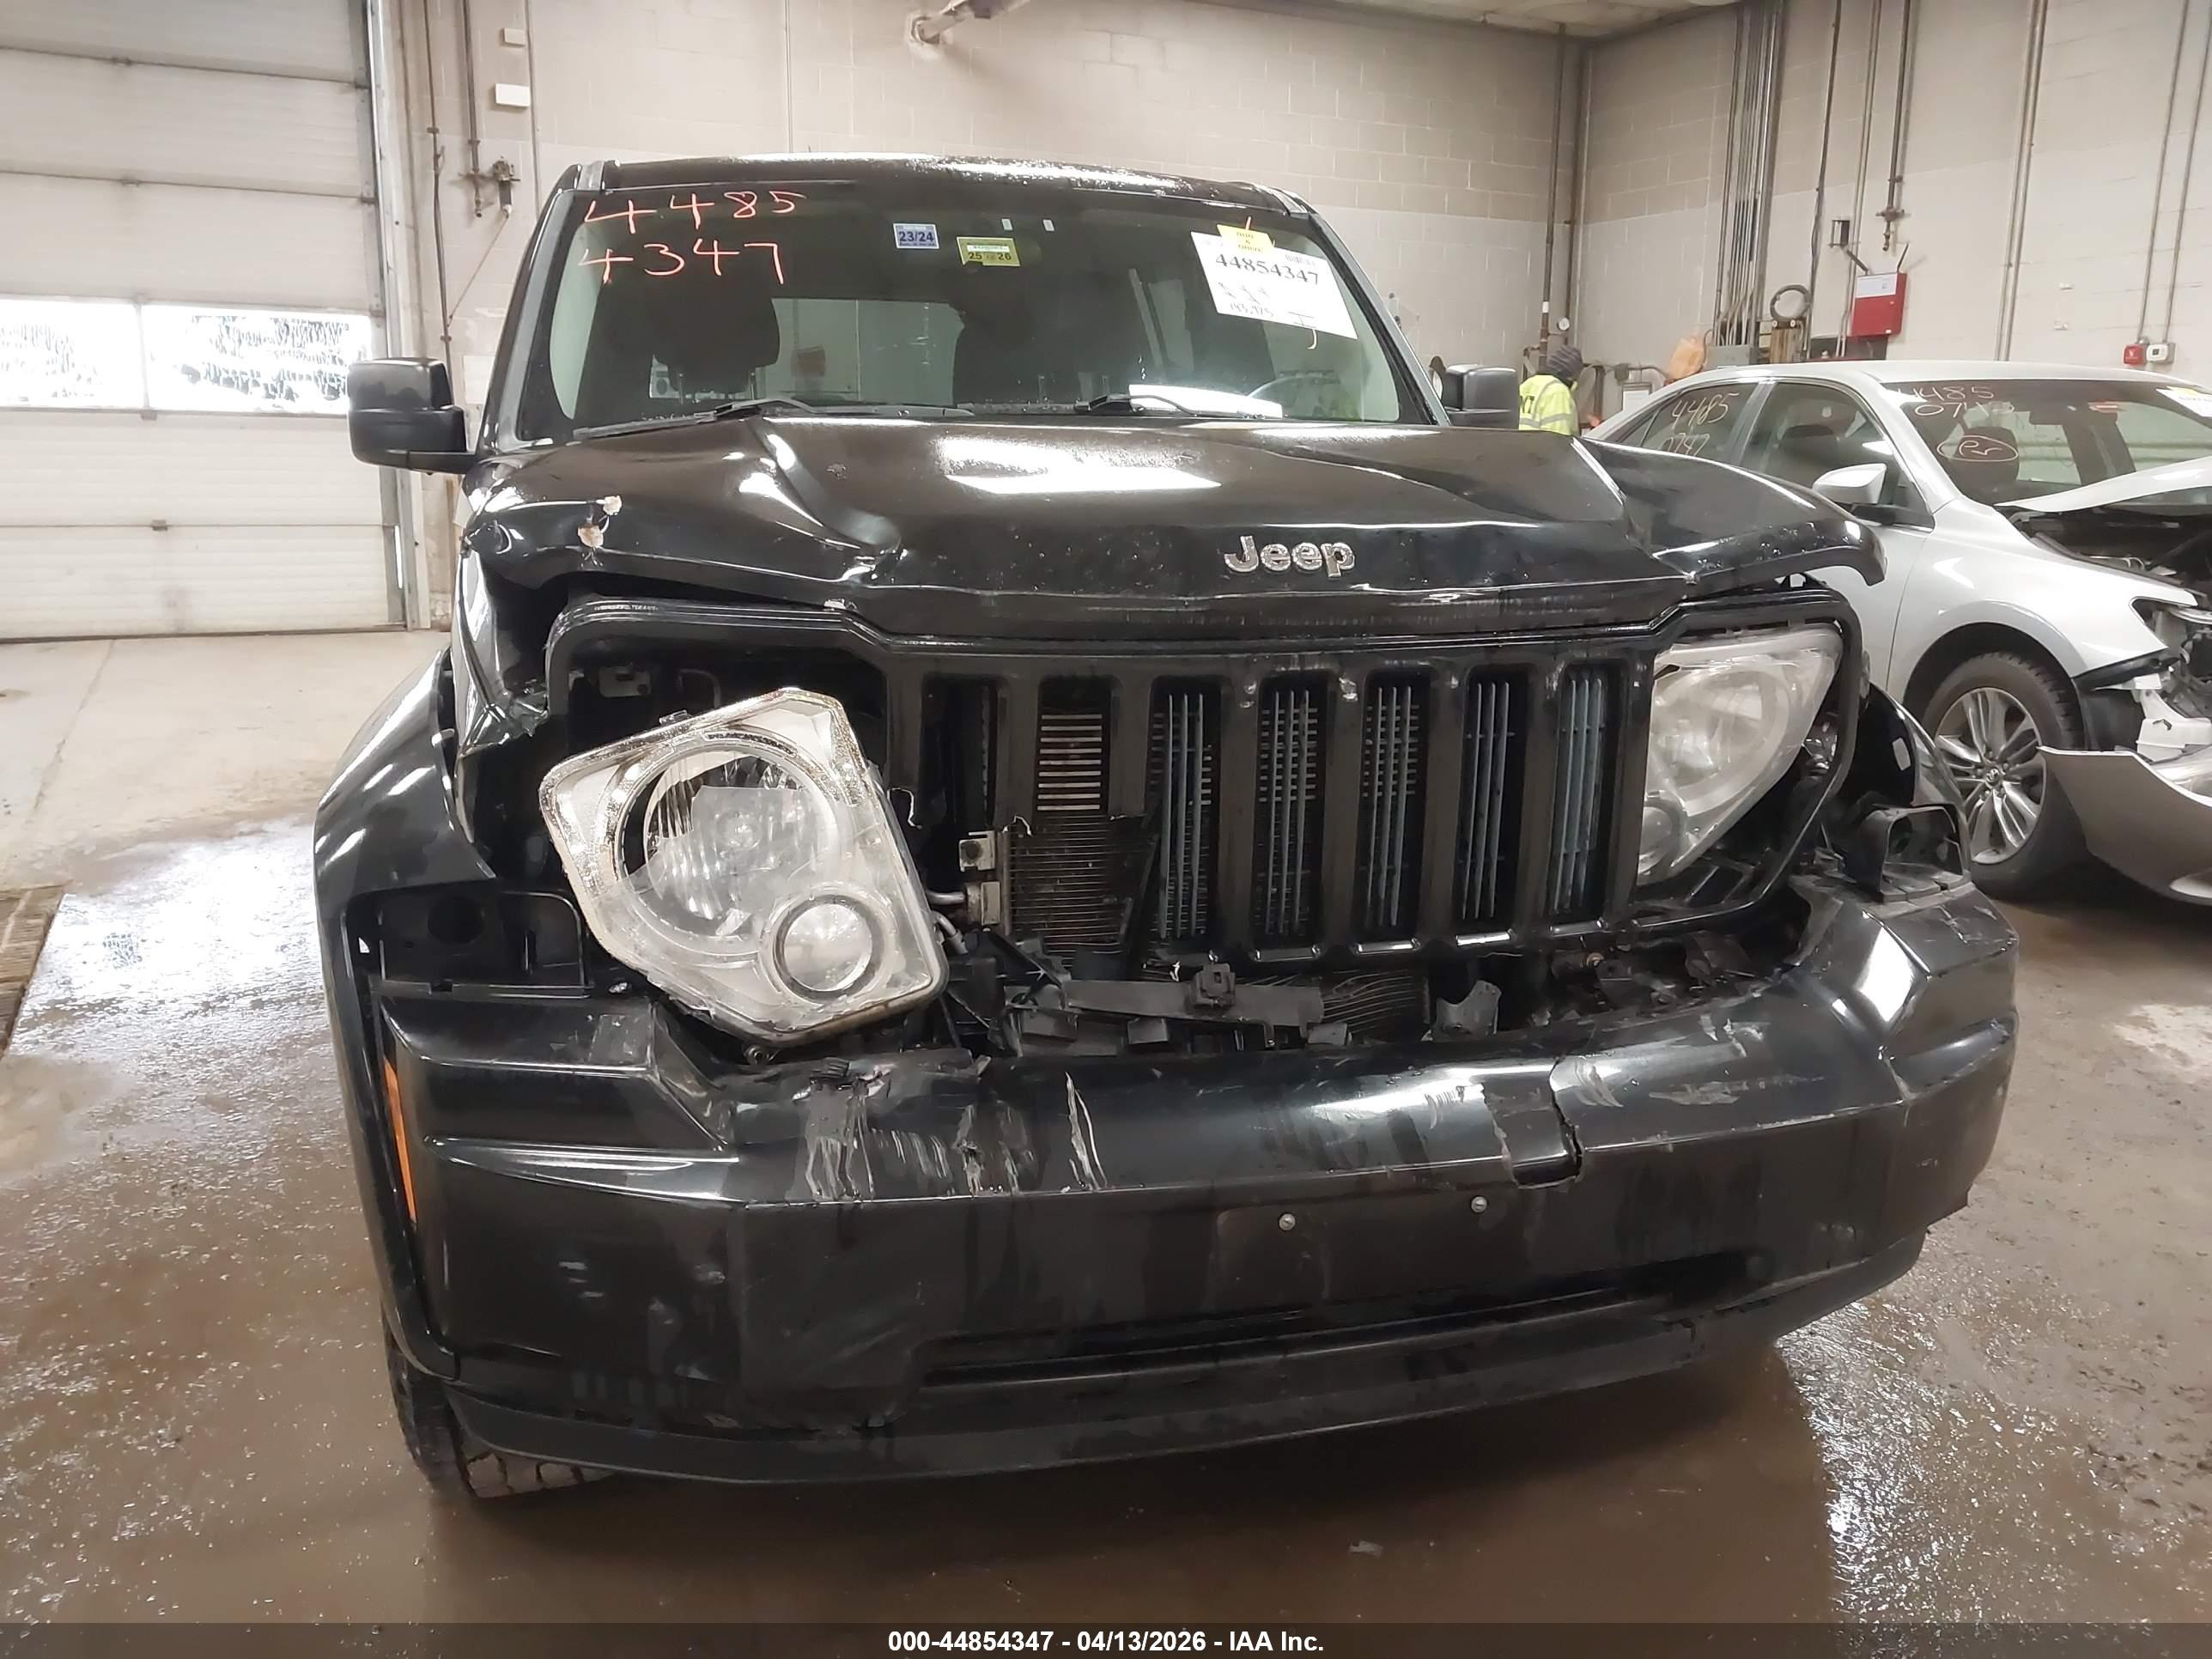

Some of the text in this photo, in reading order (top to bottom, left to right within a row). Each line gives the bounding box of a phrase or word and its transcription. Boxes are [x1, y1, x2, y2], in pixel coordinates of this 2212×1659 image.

[584, 191, 807, 234] 4485
[897, 230, 934, 243] 23/24
[578, 238, 784, 285] 4347
[1215, 252, 1319, 285] 44854347
[1223, 535, 1356, 578] Jeep
